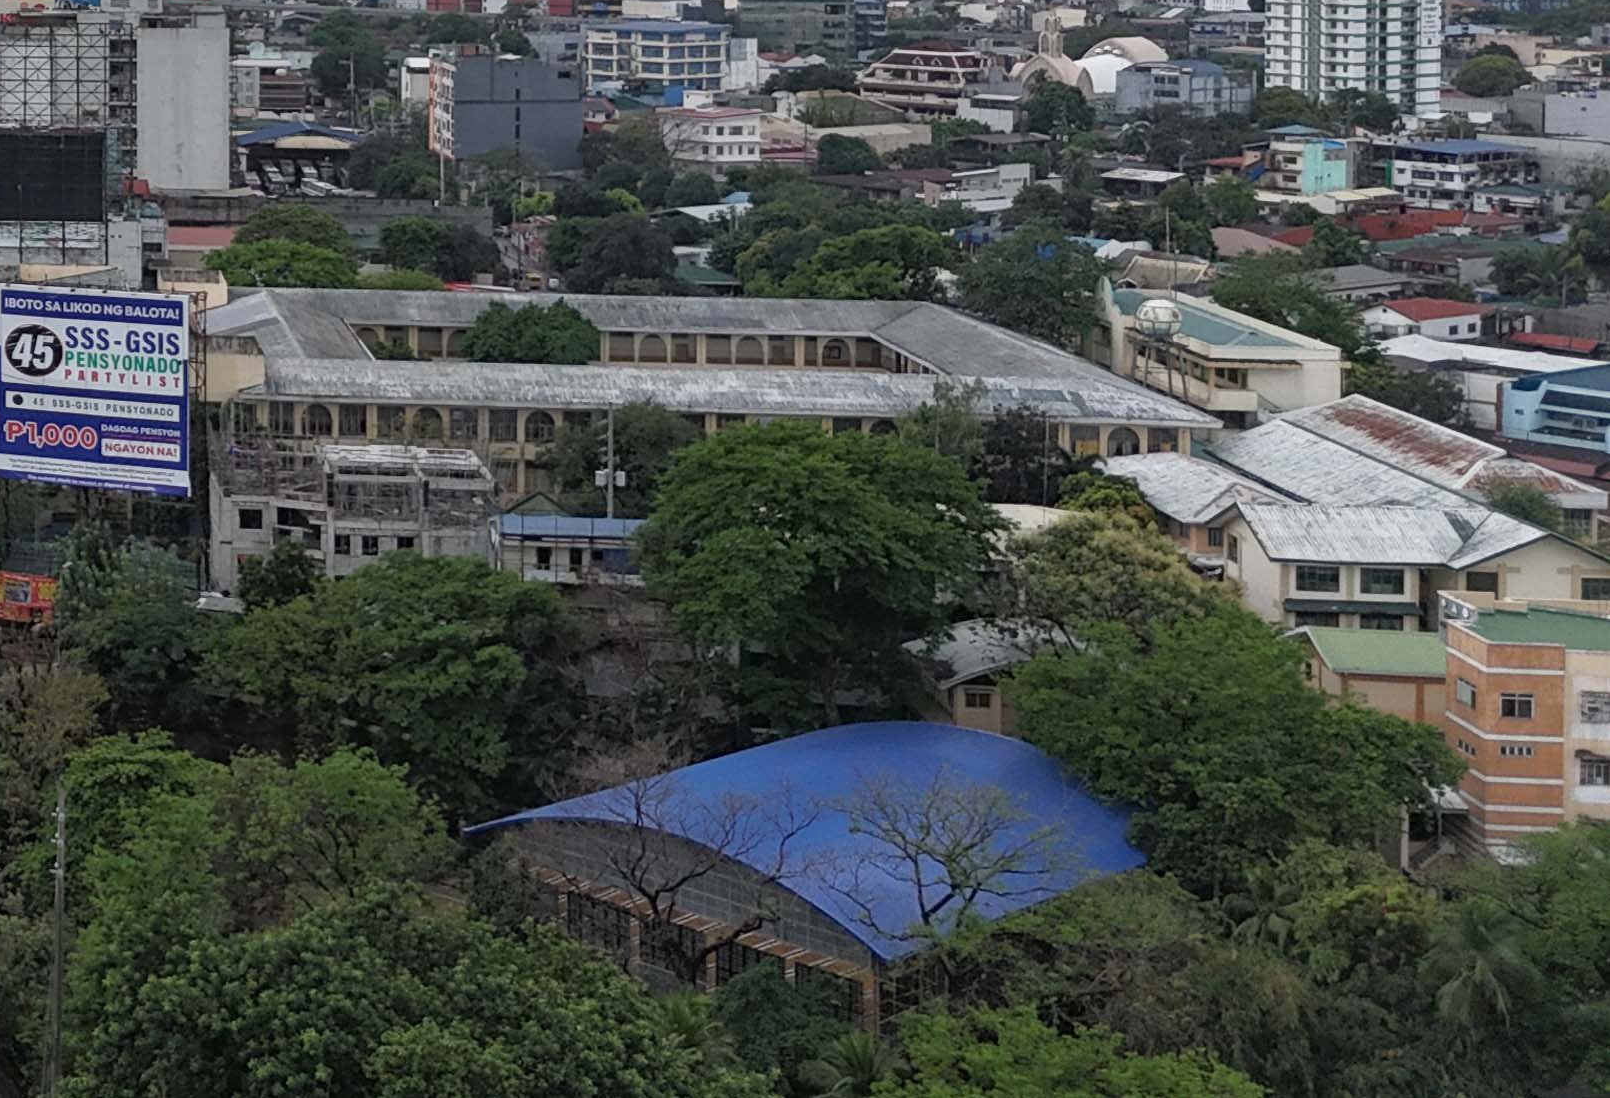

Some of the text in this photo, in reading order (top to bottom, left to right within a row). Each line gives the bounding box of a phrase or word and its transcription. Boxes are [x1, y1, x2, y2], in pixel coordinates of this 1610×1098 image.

[4, 297, 180, 320] IBOTO SA LIKOD NG BALOTA!
[11, 332, 54, 370] 45
[65, 350, 181, 374] PENSYONADO
[64, 368, 180, 388] PARTYLIST
[32, 397, 174, 417] 45 SSS-GSIS PENSYONADO
[101, 423, 181, 437] DAGDAG PENSYON
[104, 443, 177, 457] NGAYON NA!
